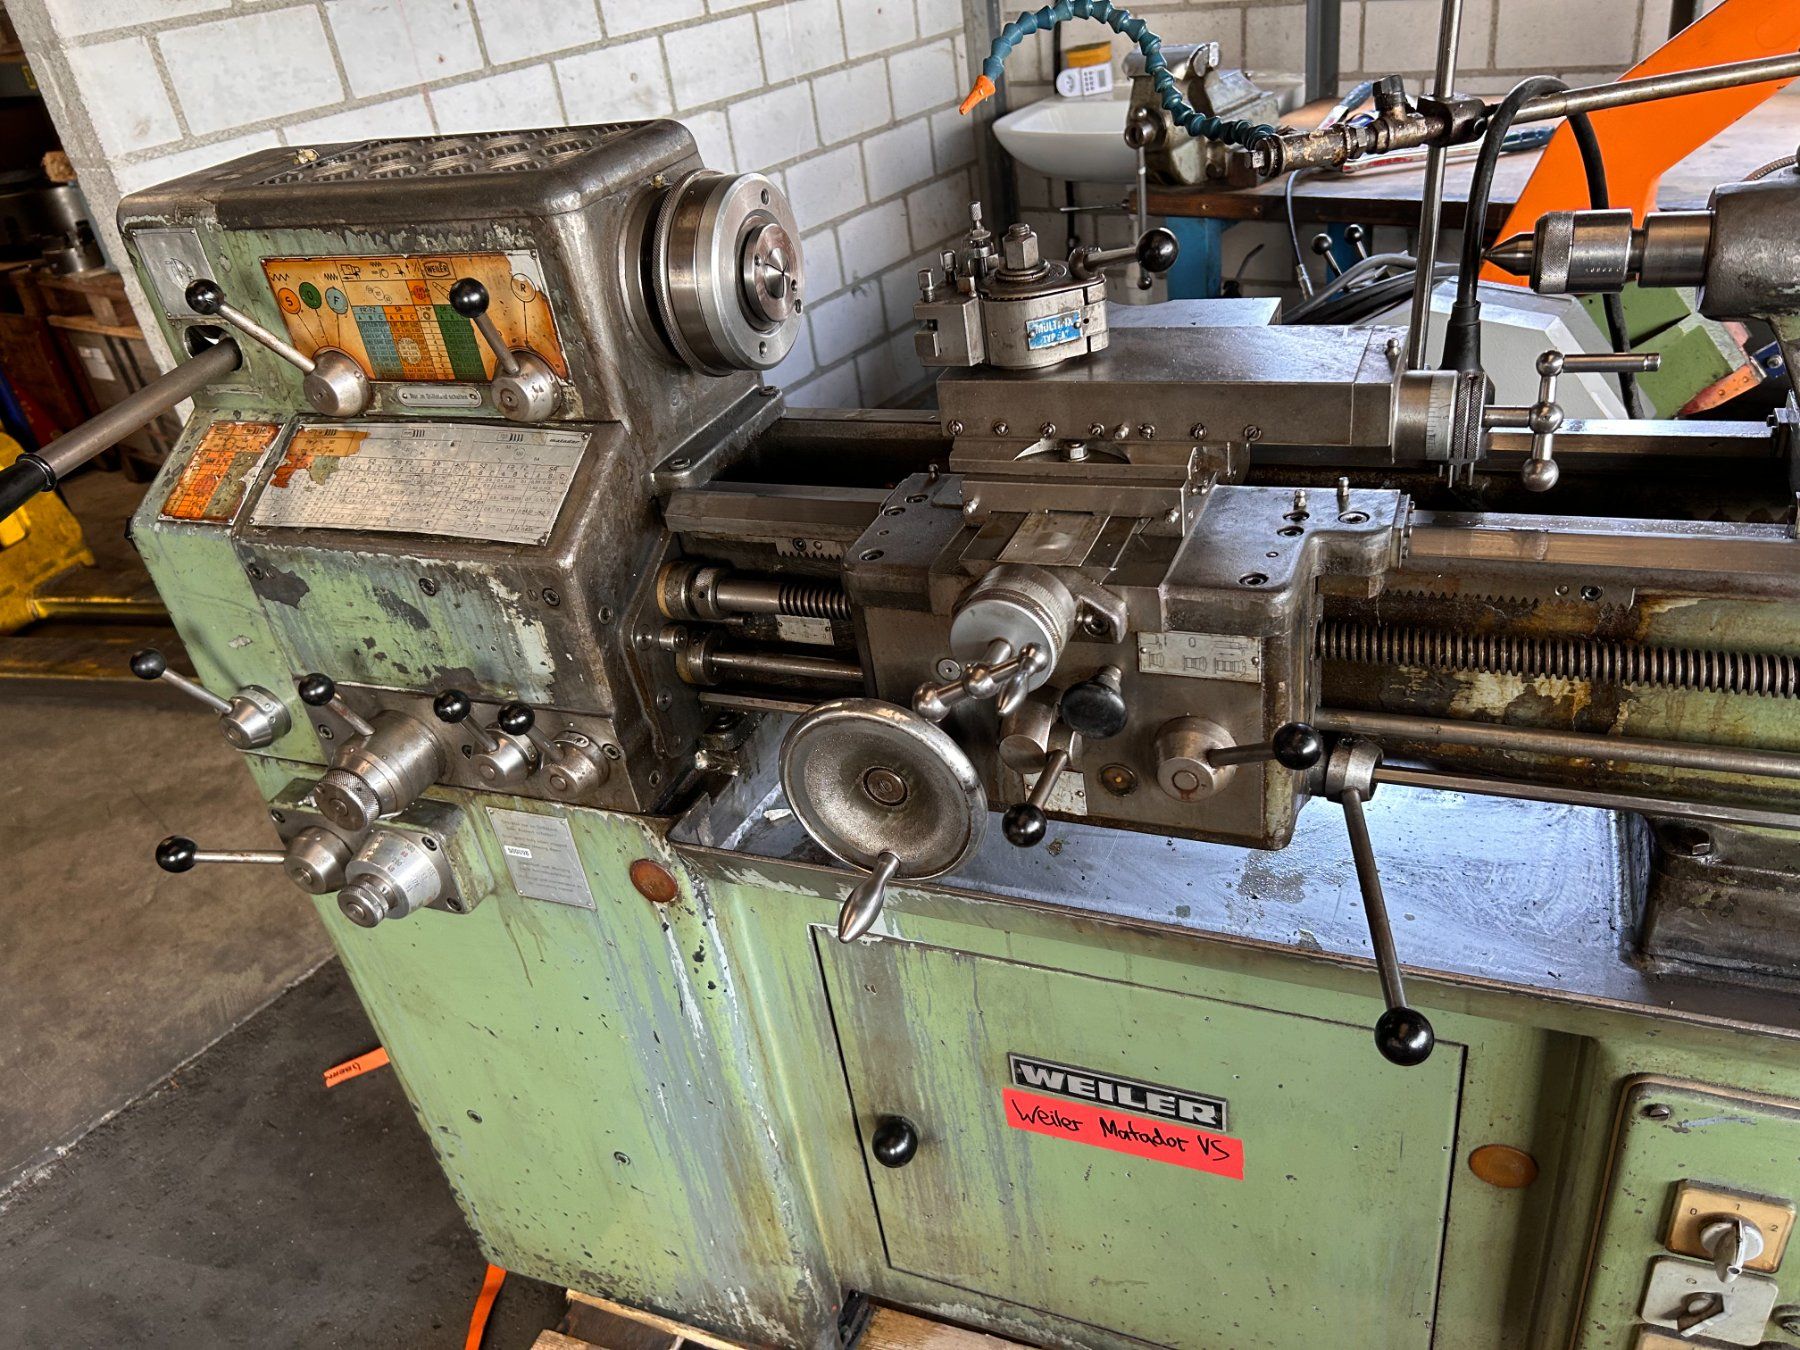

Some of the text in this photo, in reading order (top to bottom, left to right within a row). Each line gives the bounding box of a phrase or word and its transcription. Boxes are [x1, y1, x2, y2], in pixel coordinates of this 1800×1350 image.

[285, 296, 293, 306] S
[333, 295, 340, 305] F
[520, 283, 526, 293] R
[1019, 1063, 1217, 1125] WEILER
[1011, 1099, 1230, 1161] Weiler Matador VS
[1690, 1207, 1698, 1215] 0
[1770, 1224, 1778, 1232] 2
